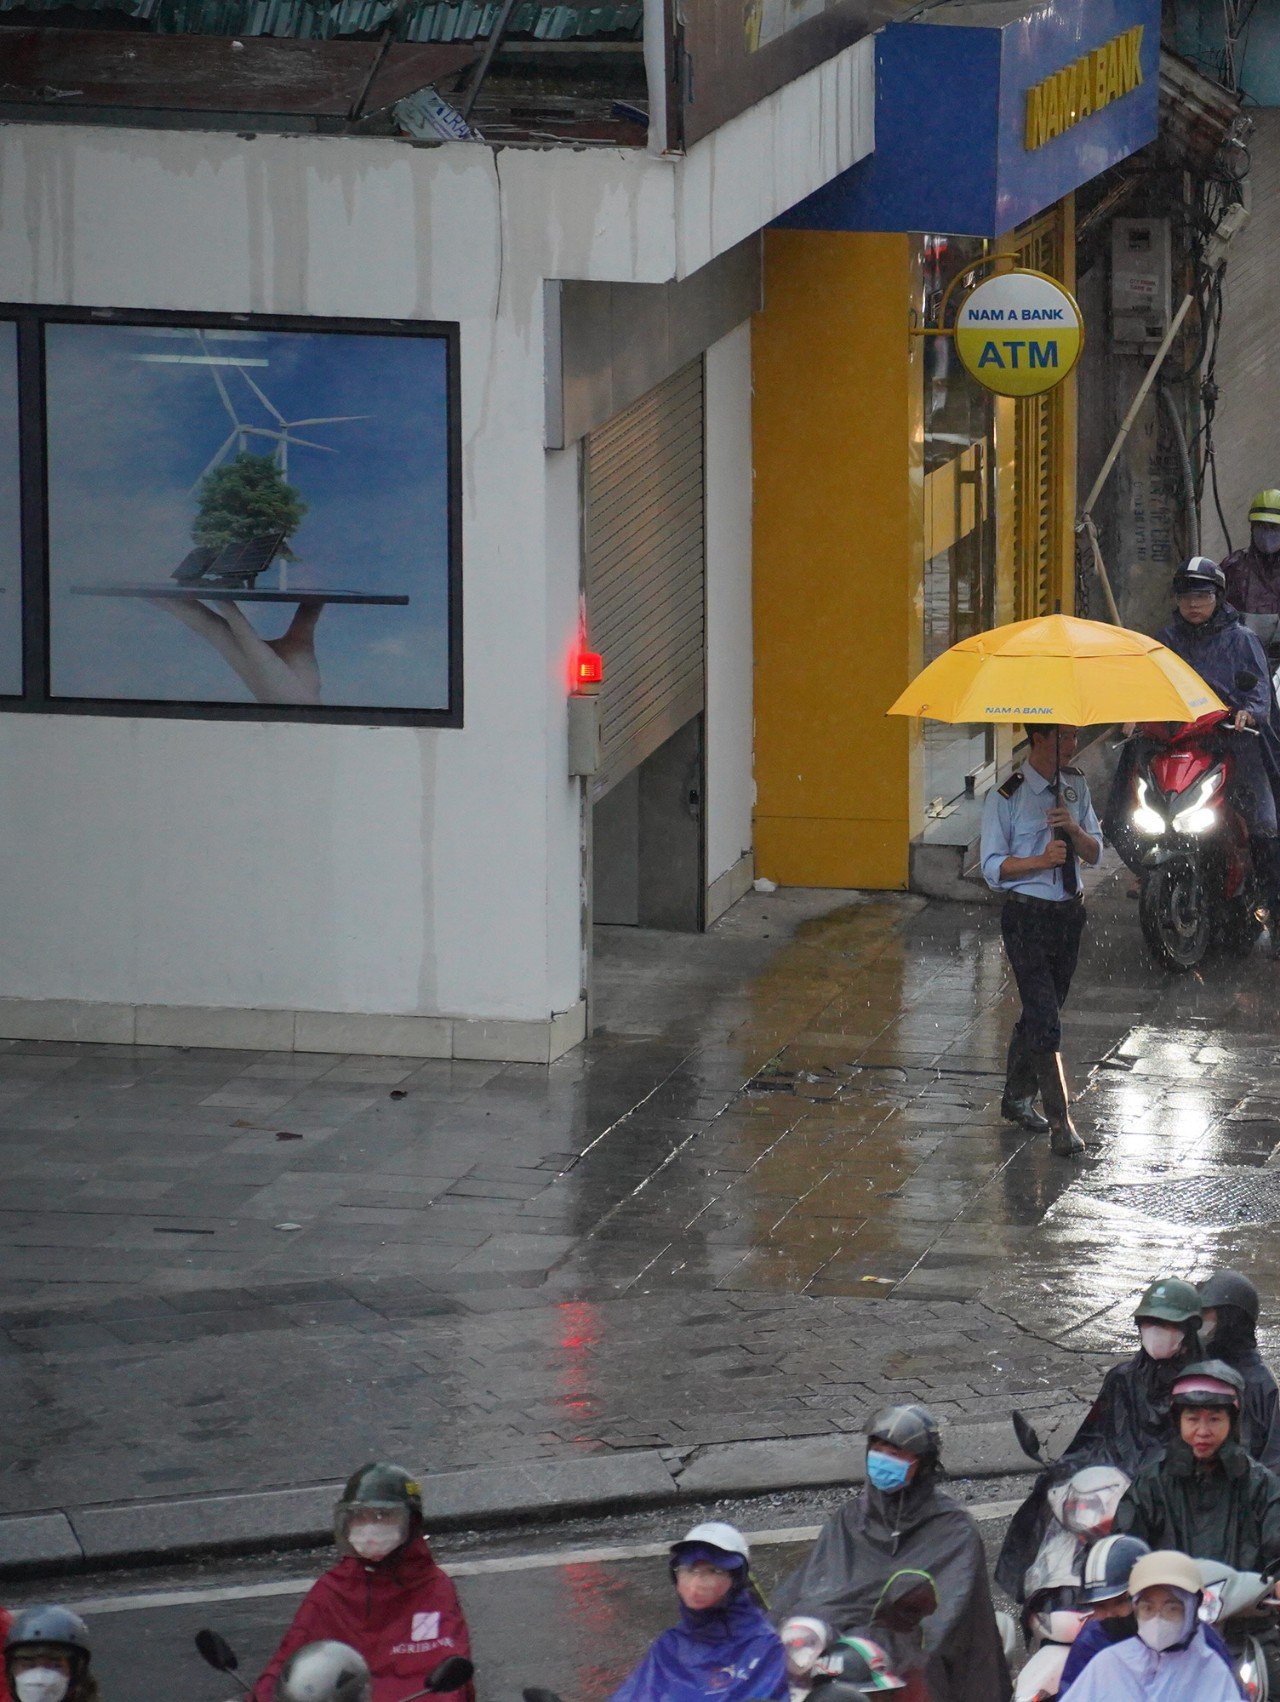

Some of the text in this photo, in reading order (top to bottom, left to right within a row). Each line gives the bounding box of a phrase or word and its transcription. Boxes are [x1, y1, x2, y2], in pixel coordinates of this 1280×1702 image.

[1024, 64, 1078, 151] NAM
[1089, 24, 1144, 112] BANK
[969, 309, 1064, 321] NAM A BANK
[978, 341, 1059, 369] ATM
